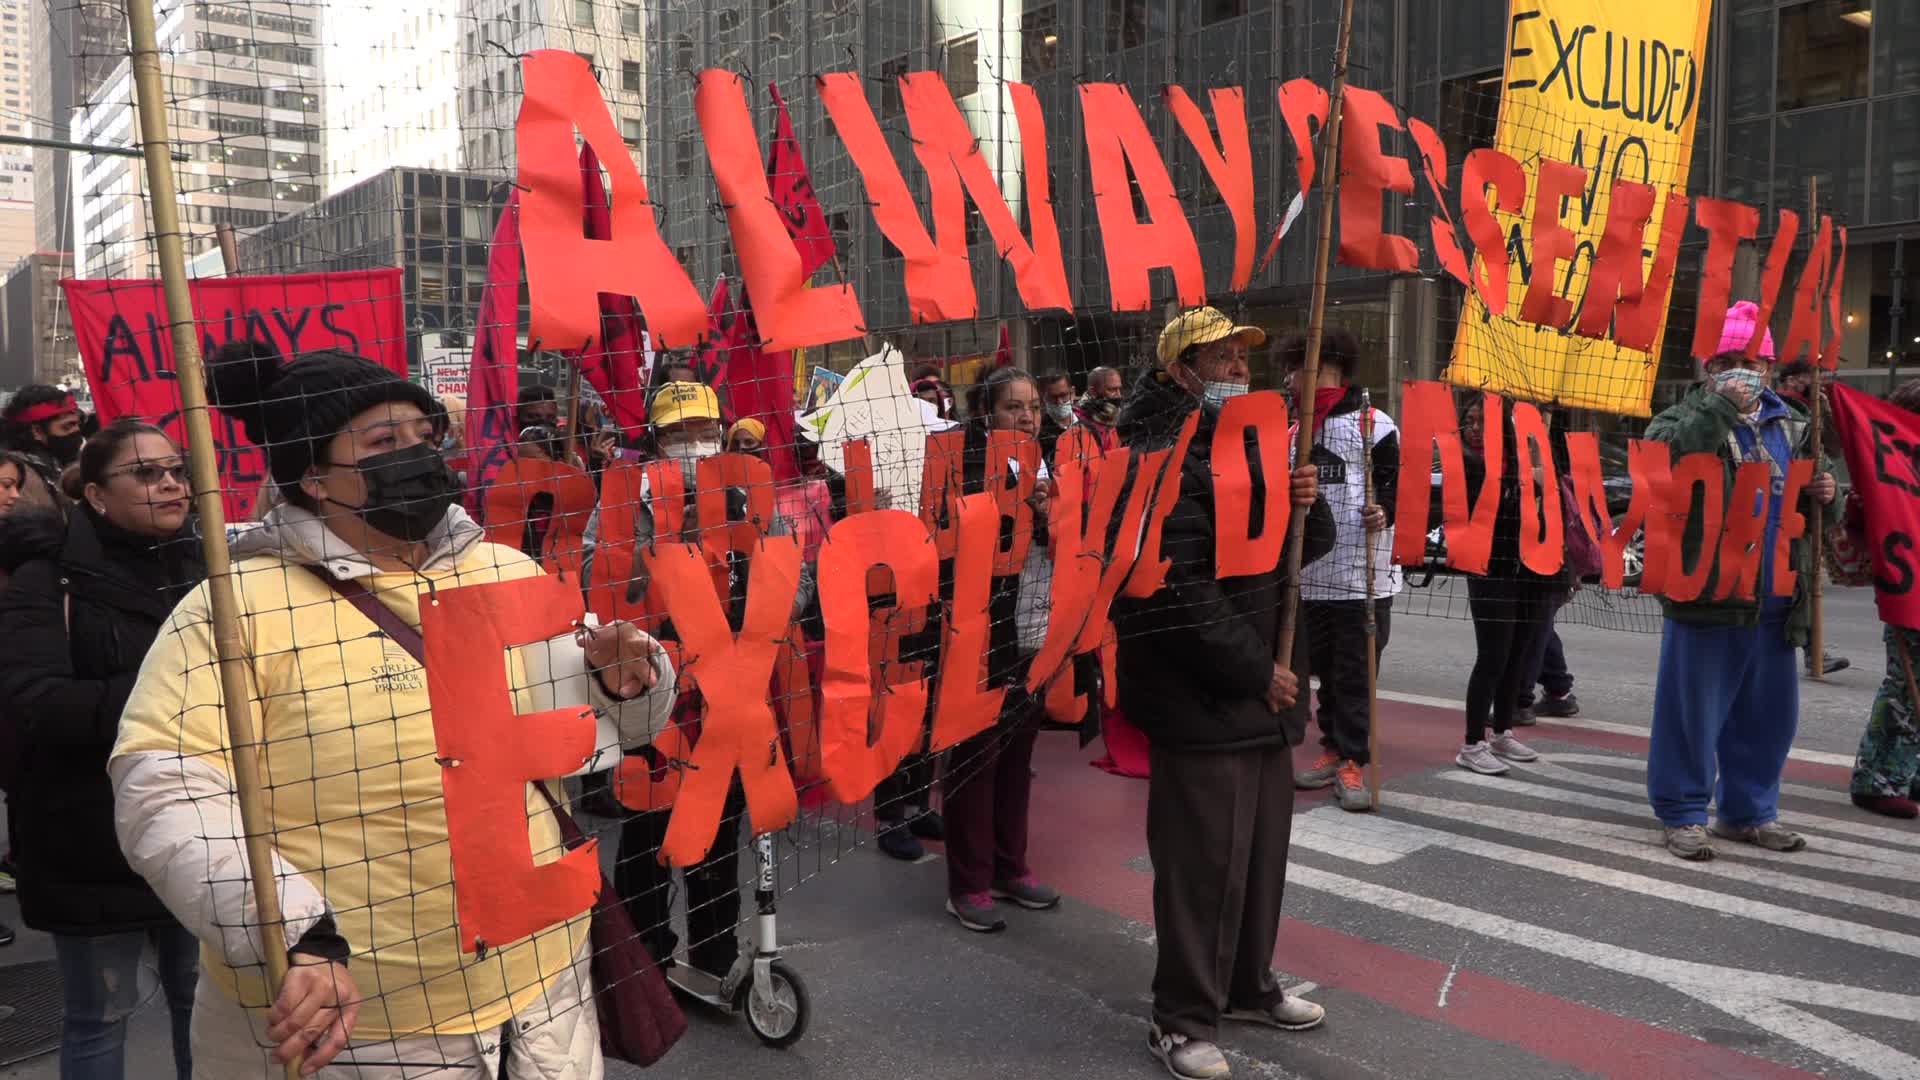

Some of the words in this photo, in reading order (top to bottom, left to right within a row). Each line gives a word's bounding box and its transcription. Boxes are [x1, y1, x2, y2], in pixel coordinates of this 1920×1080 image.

[1508, 10, 1696, 135] EXCLUDED
[515, 49, 1330, 353] ALWAYS
[1393, 380, 1564, 575] NO
[371, 664, 416, 676] STREET
[373, 673, 420, 684] VENDOR
[374, 681, 423, 693] PROJECT
